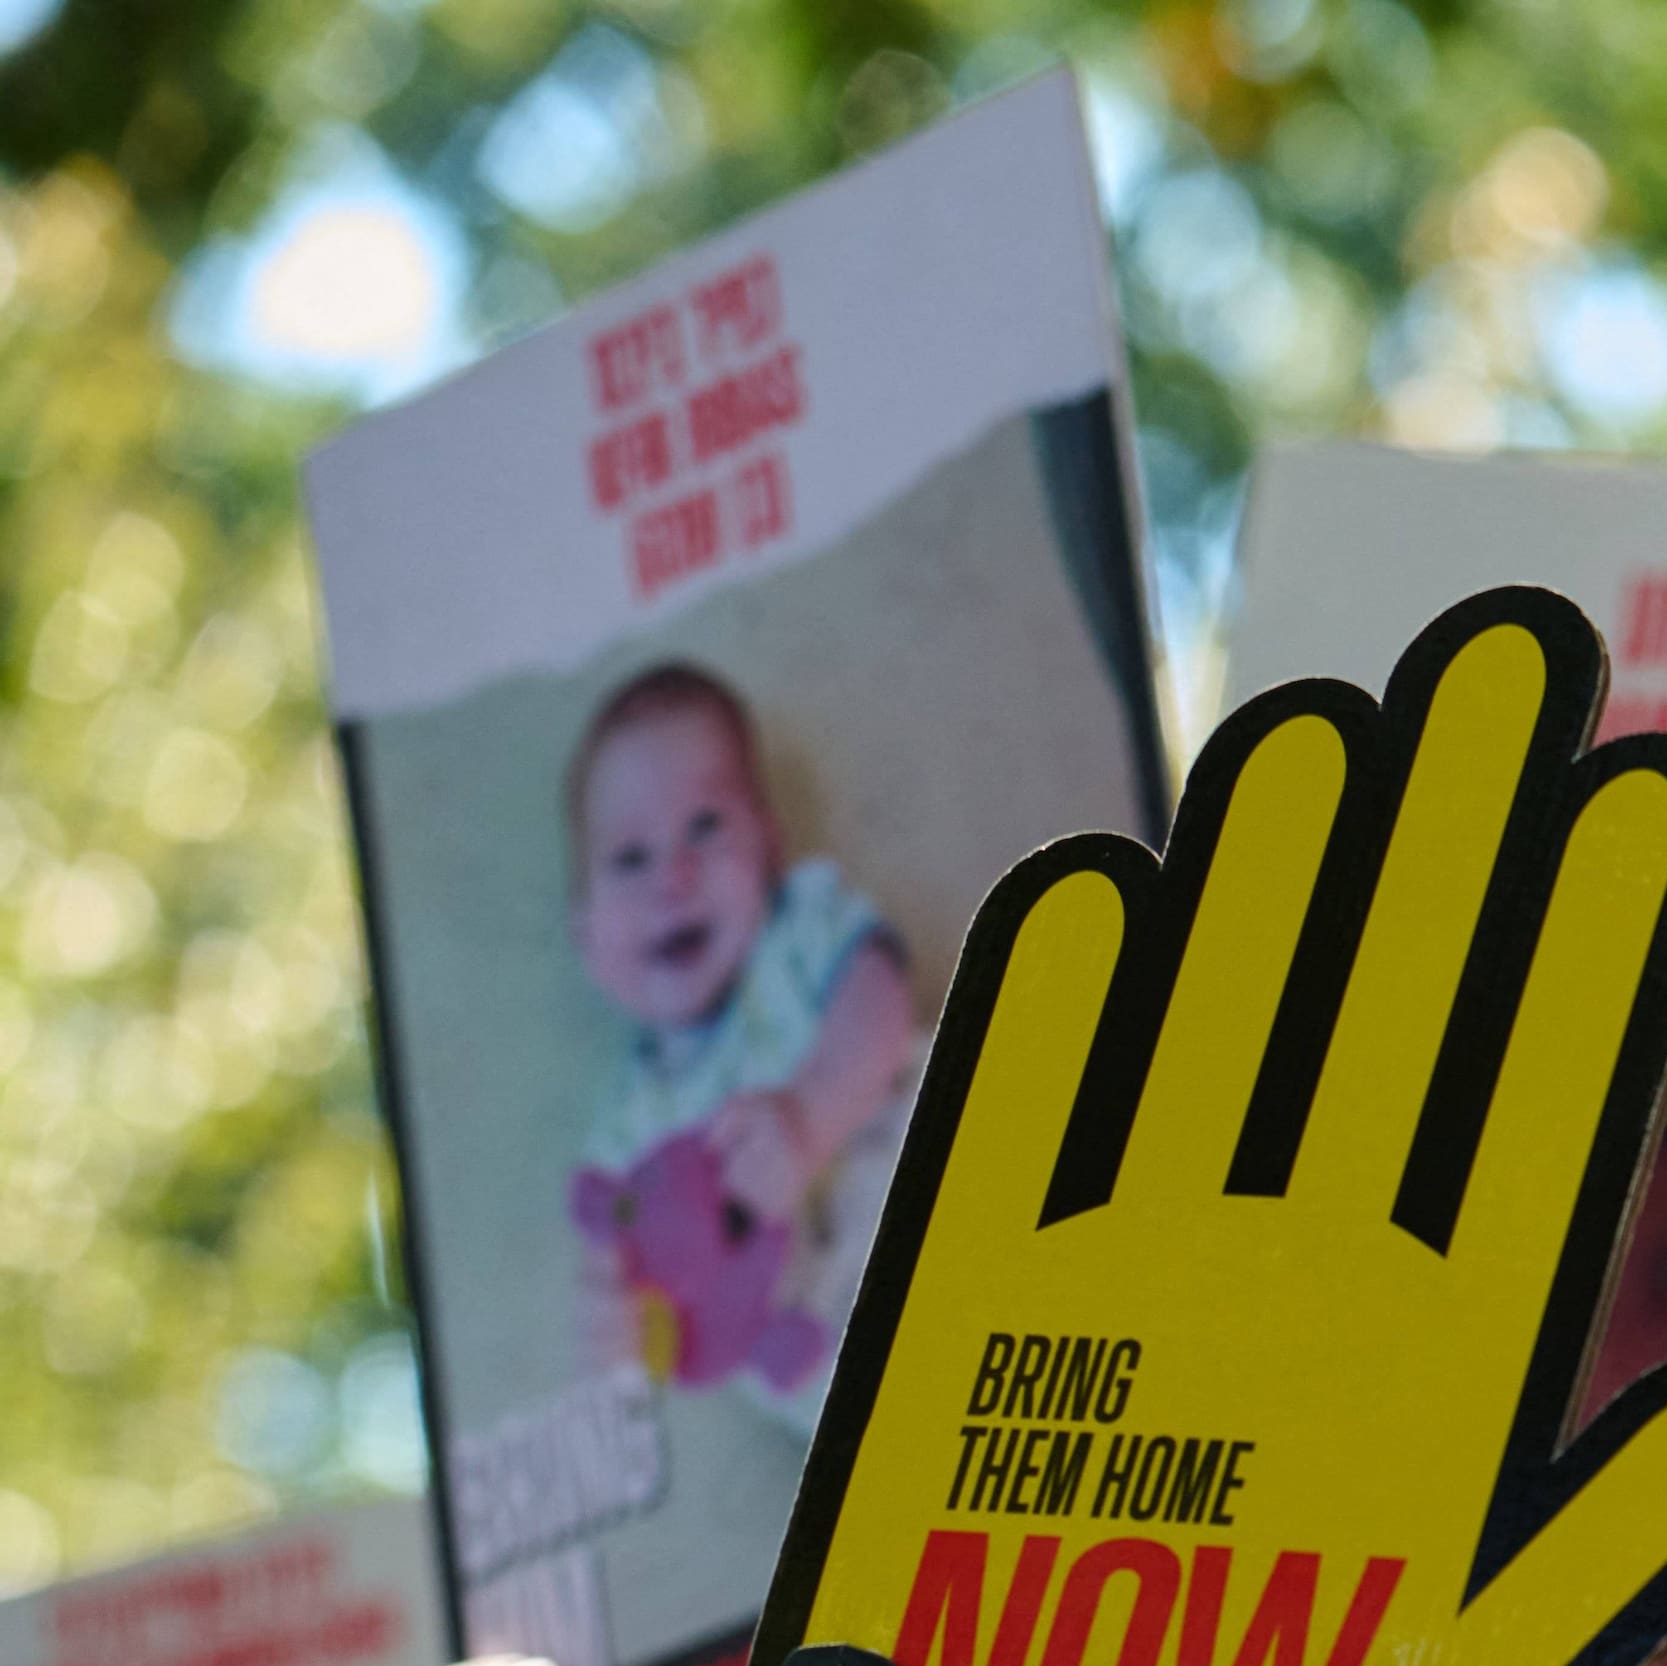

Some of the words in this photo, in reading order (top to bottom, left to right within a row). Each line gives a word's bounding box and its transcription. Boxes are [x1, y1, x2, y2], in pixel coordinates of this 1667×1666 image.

[967, 1332, 1142, 1424] BRING
[946, 1426, 1094, 1517] THEM
[1092, 1435, 1255, 1526] HOME
